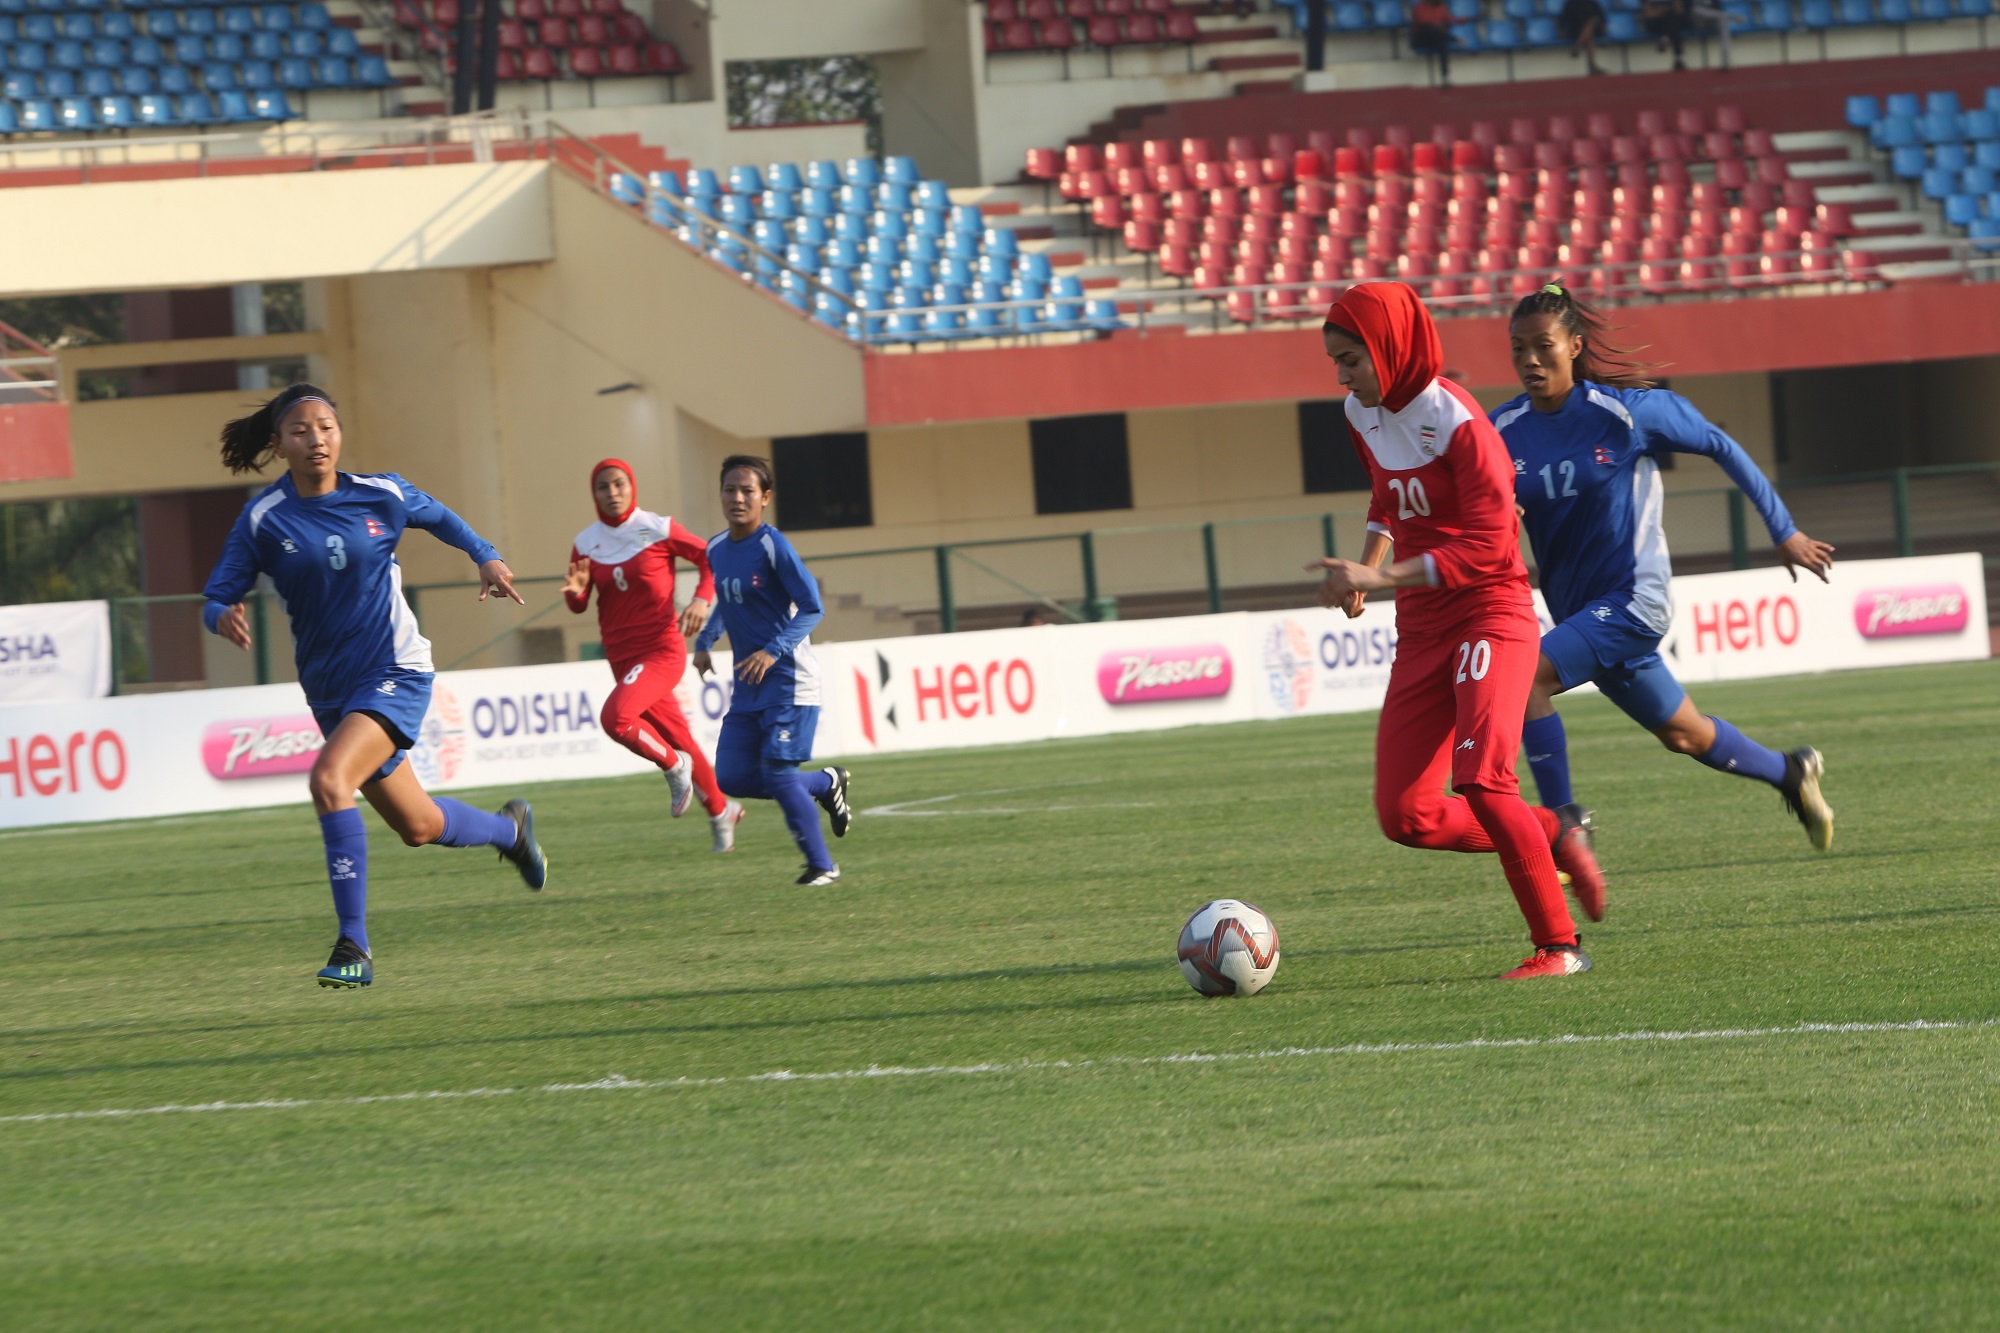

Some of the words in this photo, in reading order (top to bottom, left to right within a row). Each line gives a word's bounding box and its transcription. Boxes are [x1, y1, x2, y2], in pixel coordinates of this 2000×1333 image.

[1388, 476, 1431, 521] 20
[1538, 460, 1579, 499] 12
[326, 534, 348, 570] 3
[612, 566, 629, 592] 8
[721, 576, 744, 604] 19
[1693, 595, 1800, 654] Hero
[1866, 587, 1963, 634] Pleasure
[623, 663, 645, 685] 8
[1114, 650, 1224, 699] Pleasure
[1456, 639, 1492, 685] 20
[912, 658, 1035, 722] Hero
[472, 690, 599, 739] ODISHA
